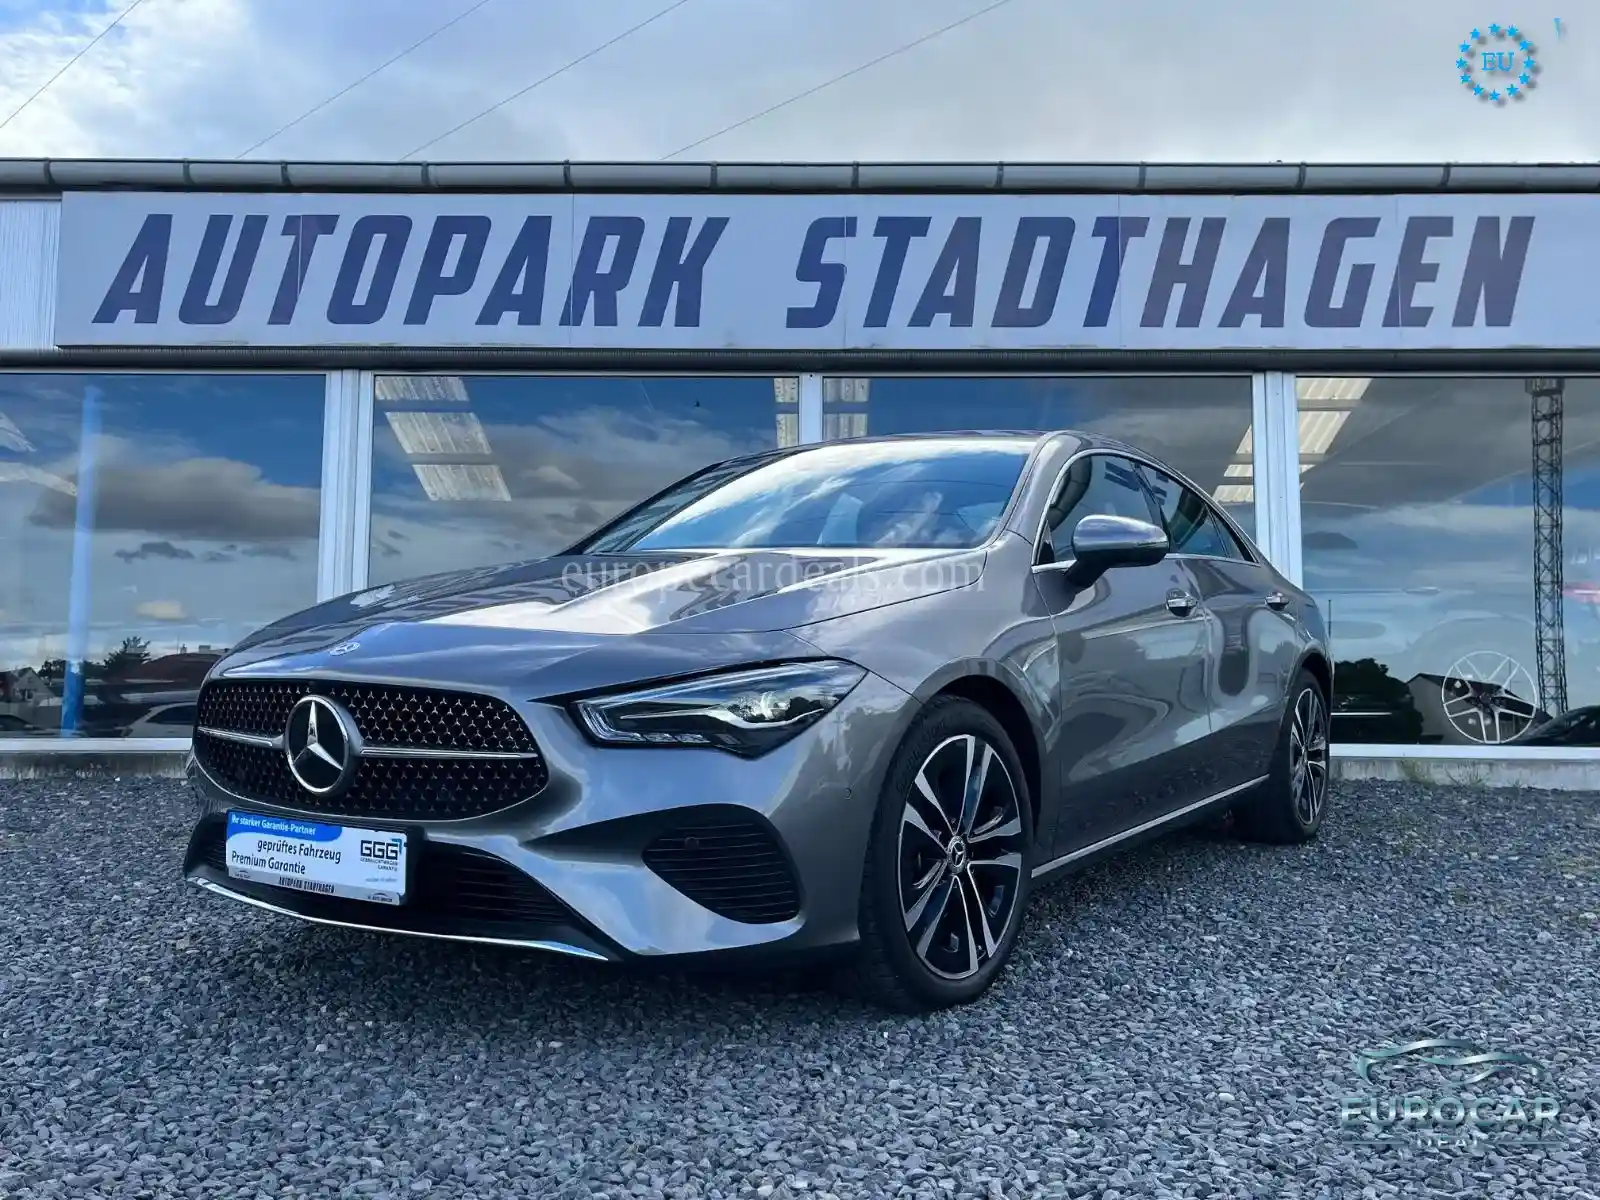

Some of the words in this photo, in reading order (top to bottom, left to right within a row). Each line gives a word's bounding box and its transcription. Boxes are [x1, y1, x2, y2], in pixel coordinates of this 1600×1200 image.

[92, 213, 730, 327] AUTOPARK
[785, 215, 1536, 328] STADTHAGEN
[240, 815, 261, 828] starker
[261, 819, 316, 836] Garantie-Partner
[257, 839, 297, 855] geprüftes
[299, 843, 341, 864] Fahrzeug
[361, 840, 398, 860] GGG
[231, 851, 266, 868] Premium
[268, 856, 306, 875] Garantie
